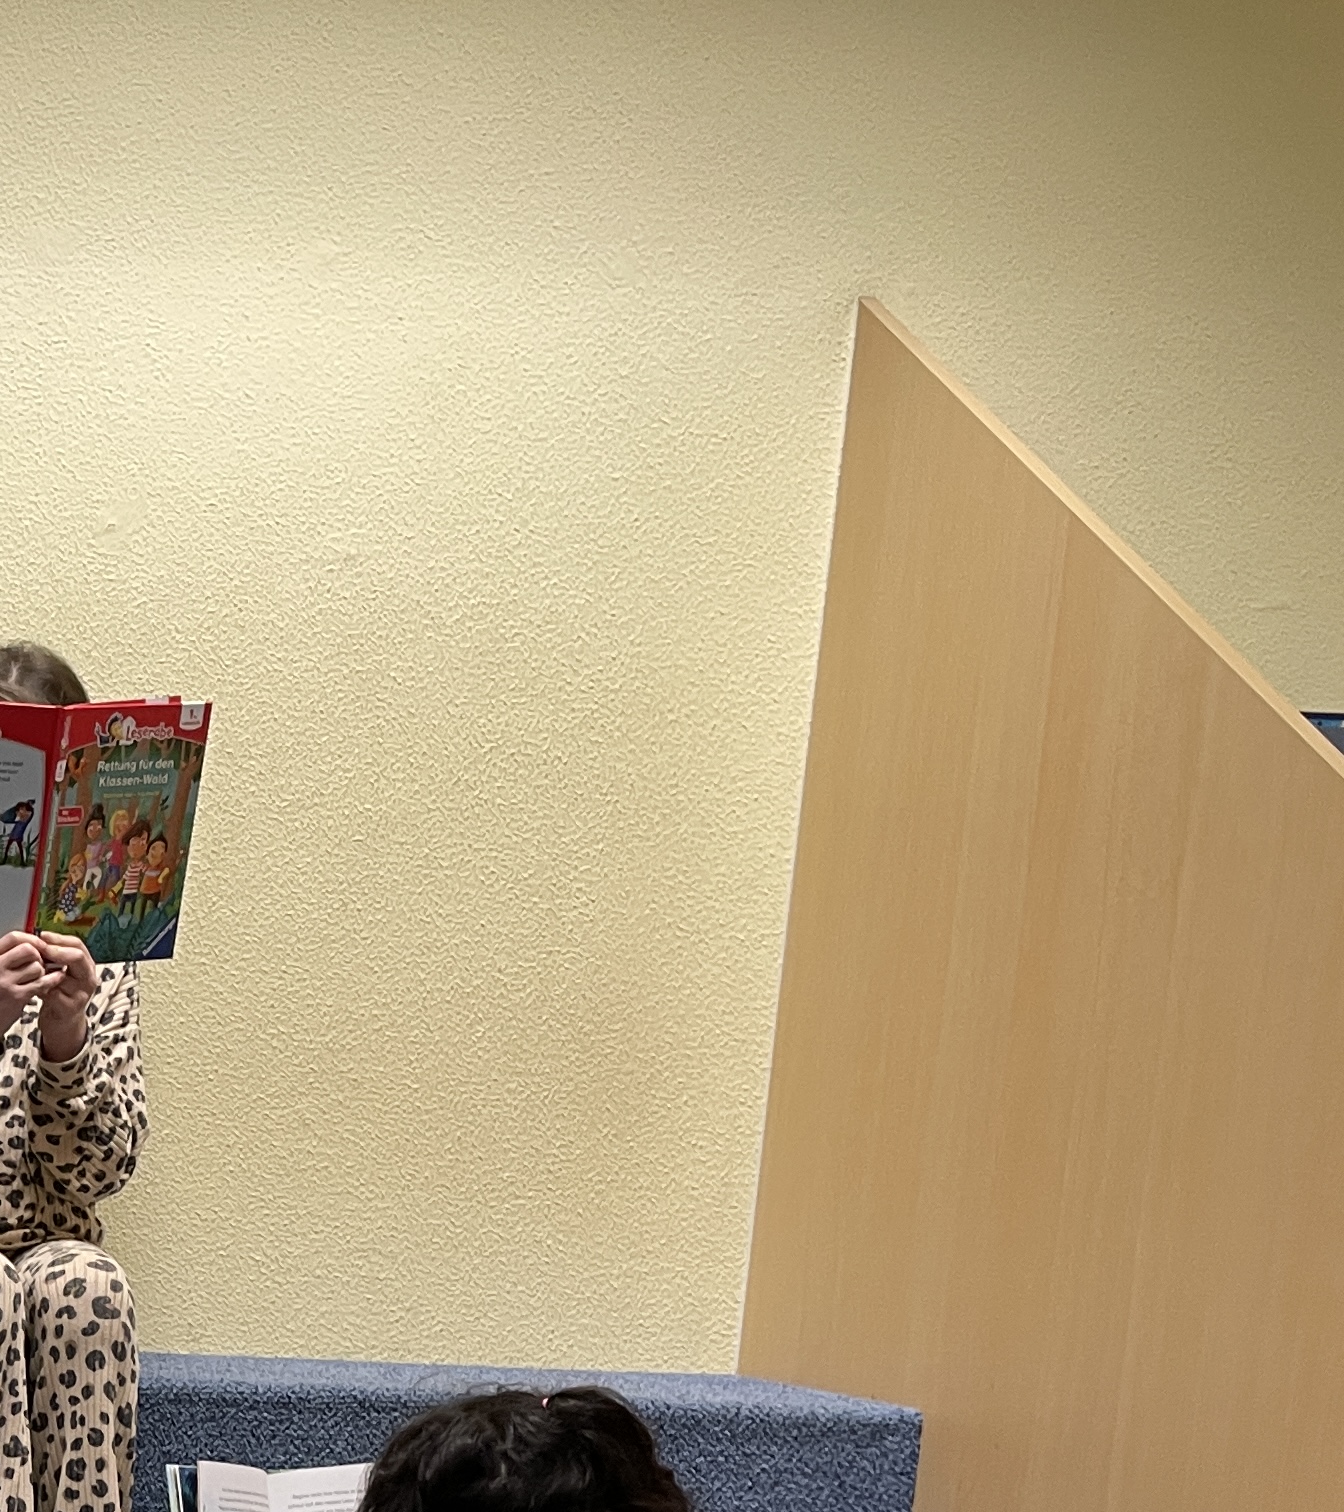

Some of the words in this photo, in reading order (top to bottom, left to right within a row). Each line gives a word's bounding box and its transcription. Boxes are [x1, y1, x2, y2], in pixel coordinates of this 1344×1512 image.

[125, 723, 174, 742] Leserabe
[96, 760, 137, 774] Rettung
[138, 759, 153, 770] für
[155, 758, 175, 769] den
[98, 773, 169, 788] Klassen-Wald
